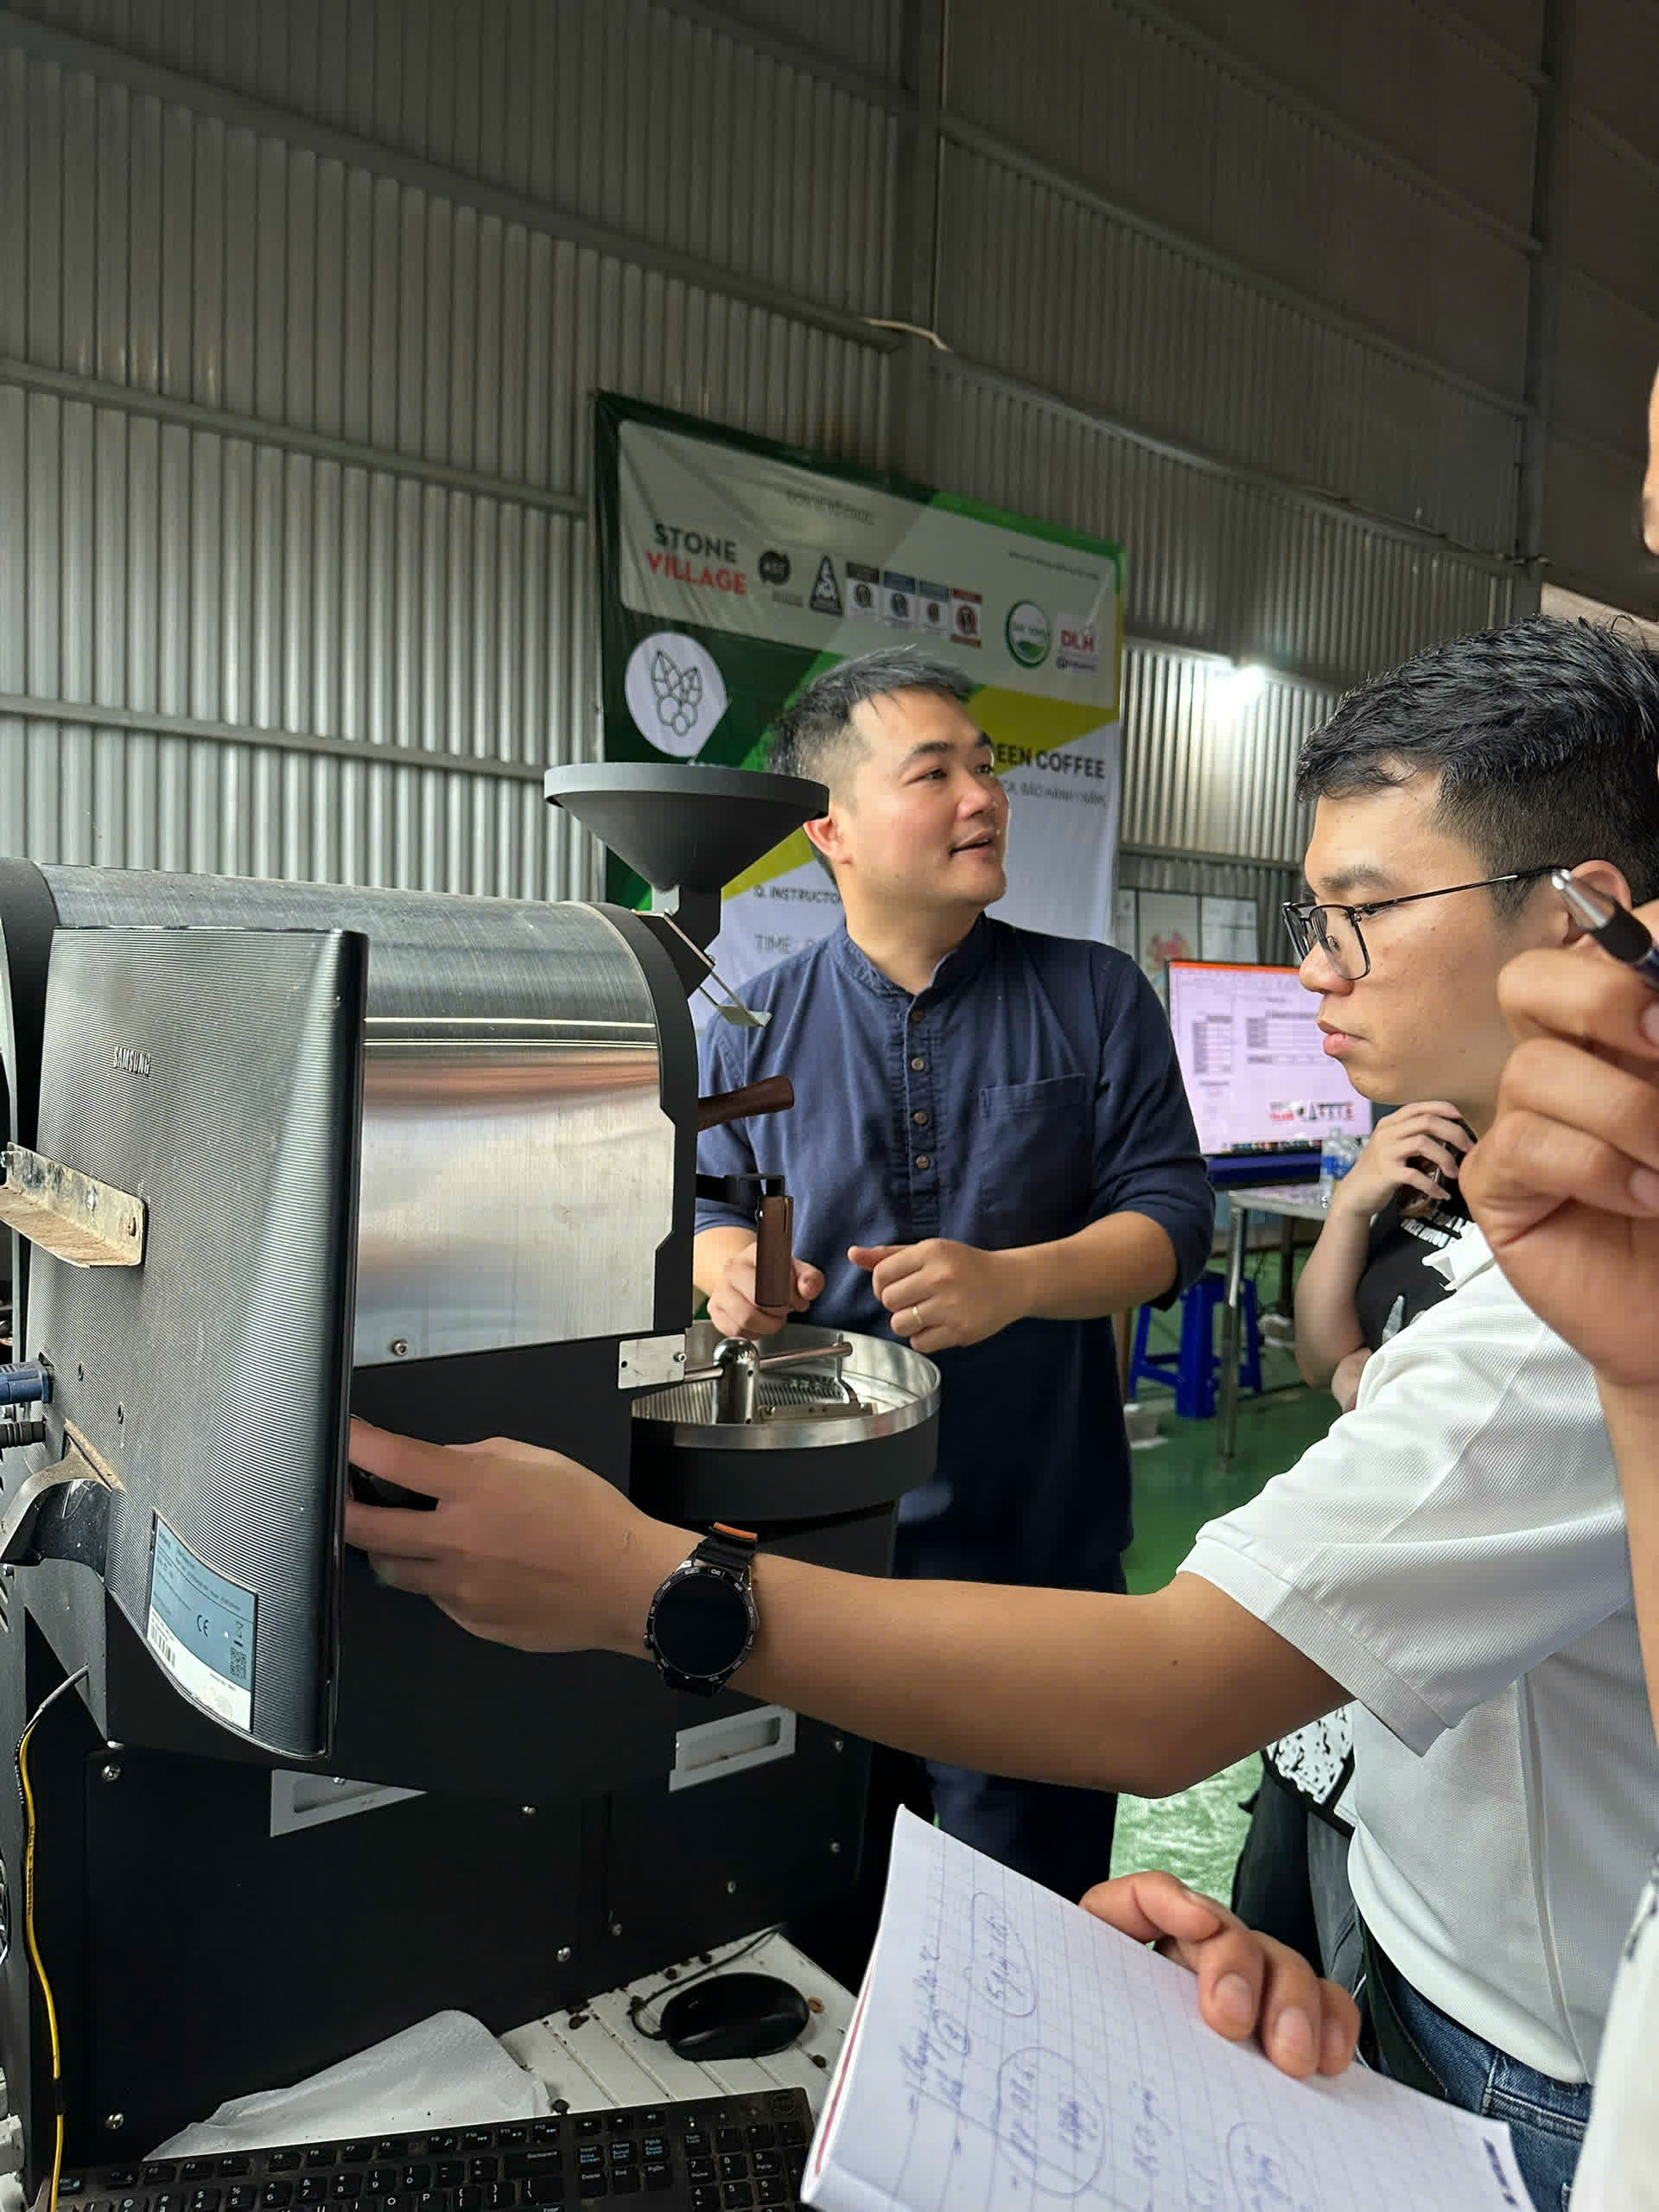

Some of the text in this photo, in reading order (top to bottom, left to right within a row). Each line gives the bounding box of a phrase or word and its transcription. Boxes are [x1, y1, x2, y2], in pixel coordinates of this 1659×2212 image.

[654, 522, 737, 564] STONE
[645, 549, 747, 595] VILLAGE
[996, 742, 1105, 779] EEN COFFEE
[113, 1046, 152, 1075] SAMSUNG
